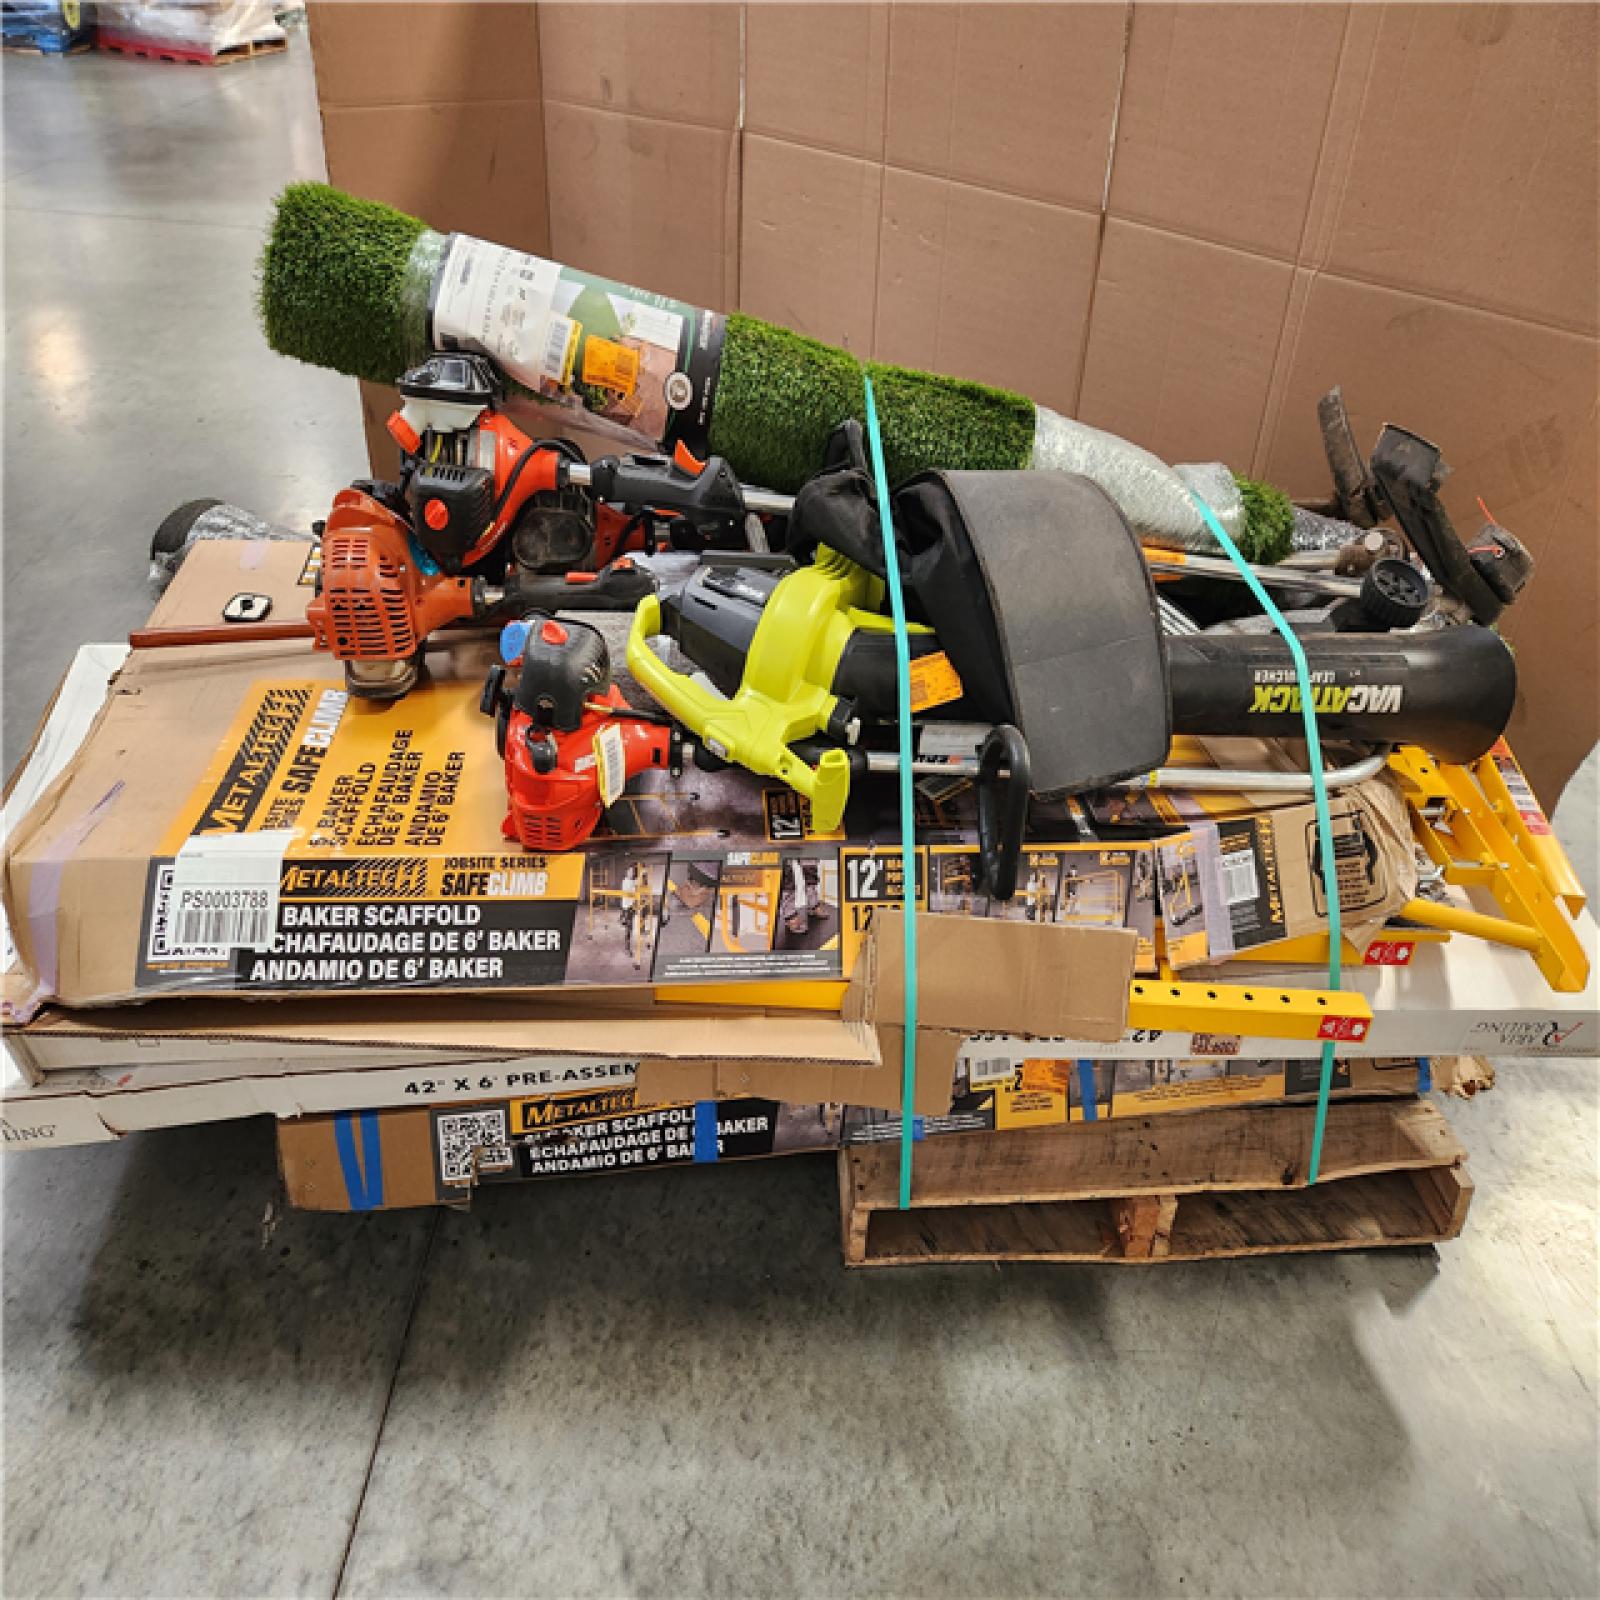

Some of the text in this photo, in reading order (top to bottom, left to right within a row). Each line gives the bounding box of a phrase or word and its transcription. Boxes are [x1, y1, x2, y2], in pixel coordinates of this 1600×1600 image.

[445, 857, 548, 870] JOBSITE SERIES
[440, 871, 549, 896] SAFECLIMB
[180, 889, 270, 909] PS0003788
[283, 905, 482, 927] BAKER SCAFFOLD
[256, 930, 561, 954] CHAFAUDAGE DE 6' BAKER
[250, 957, 505, 982] ANDAMIO DE 6' BAKER
[453, 1076, 471, 1091] X
[612, 1106, 696, 1134] SCAFFOL
[532, 1151, 616, 1174] ANDAMIO
